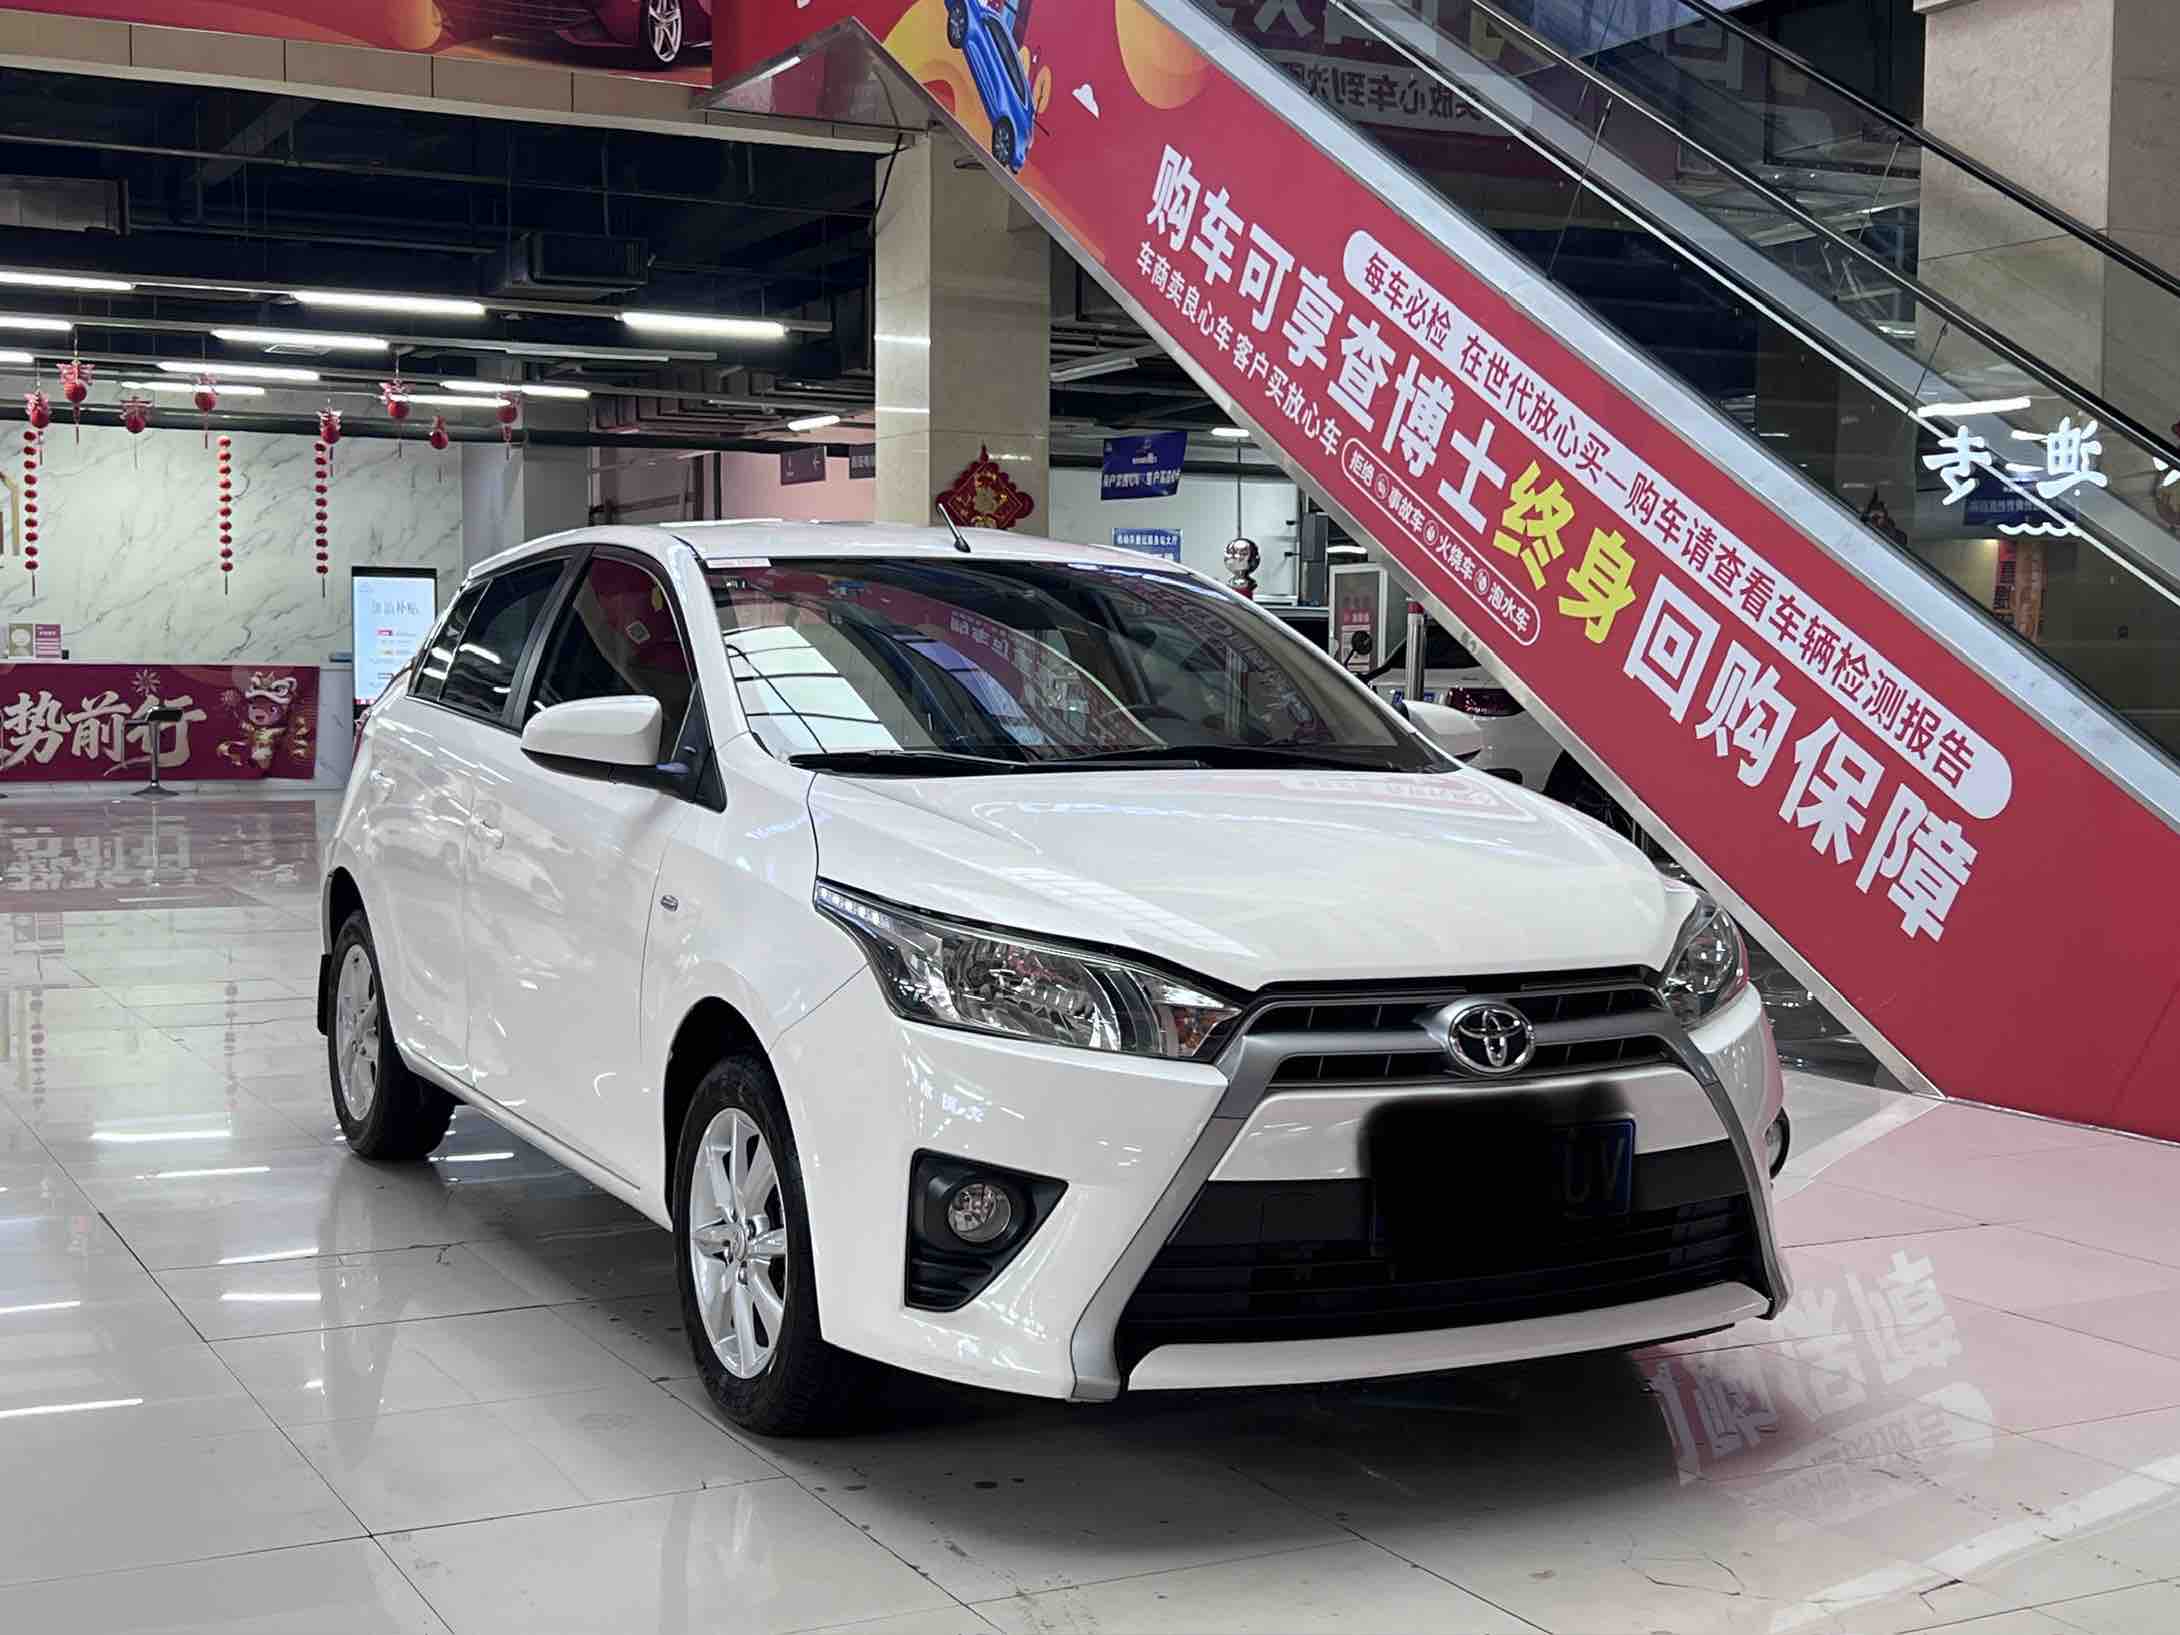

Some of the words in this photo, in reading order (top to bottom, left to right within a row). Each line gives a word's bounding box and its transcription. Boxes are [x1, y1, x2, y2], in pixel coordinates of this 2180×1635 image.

[1136, 240, 1234, 352] 车商卖良心车
[1233, 332, 1342, 456] 客户买放心车
[1364, 252, 1451, 352] 每车必检
[1147, 143, 1979, 943] 购车可享查博士终身回购保障
[1434, 534, 1477, 581] 火烧车
[1486, 581, 1531, 633] 泡水车
